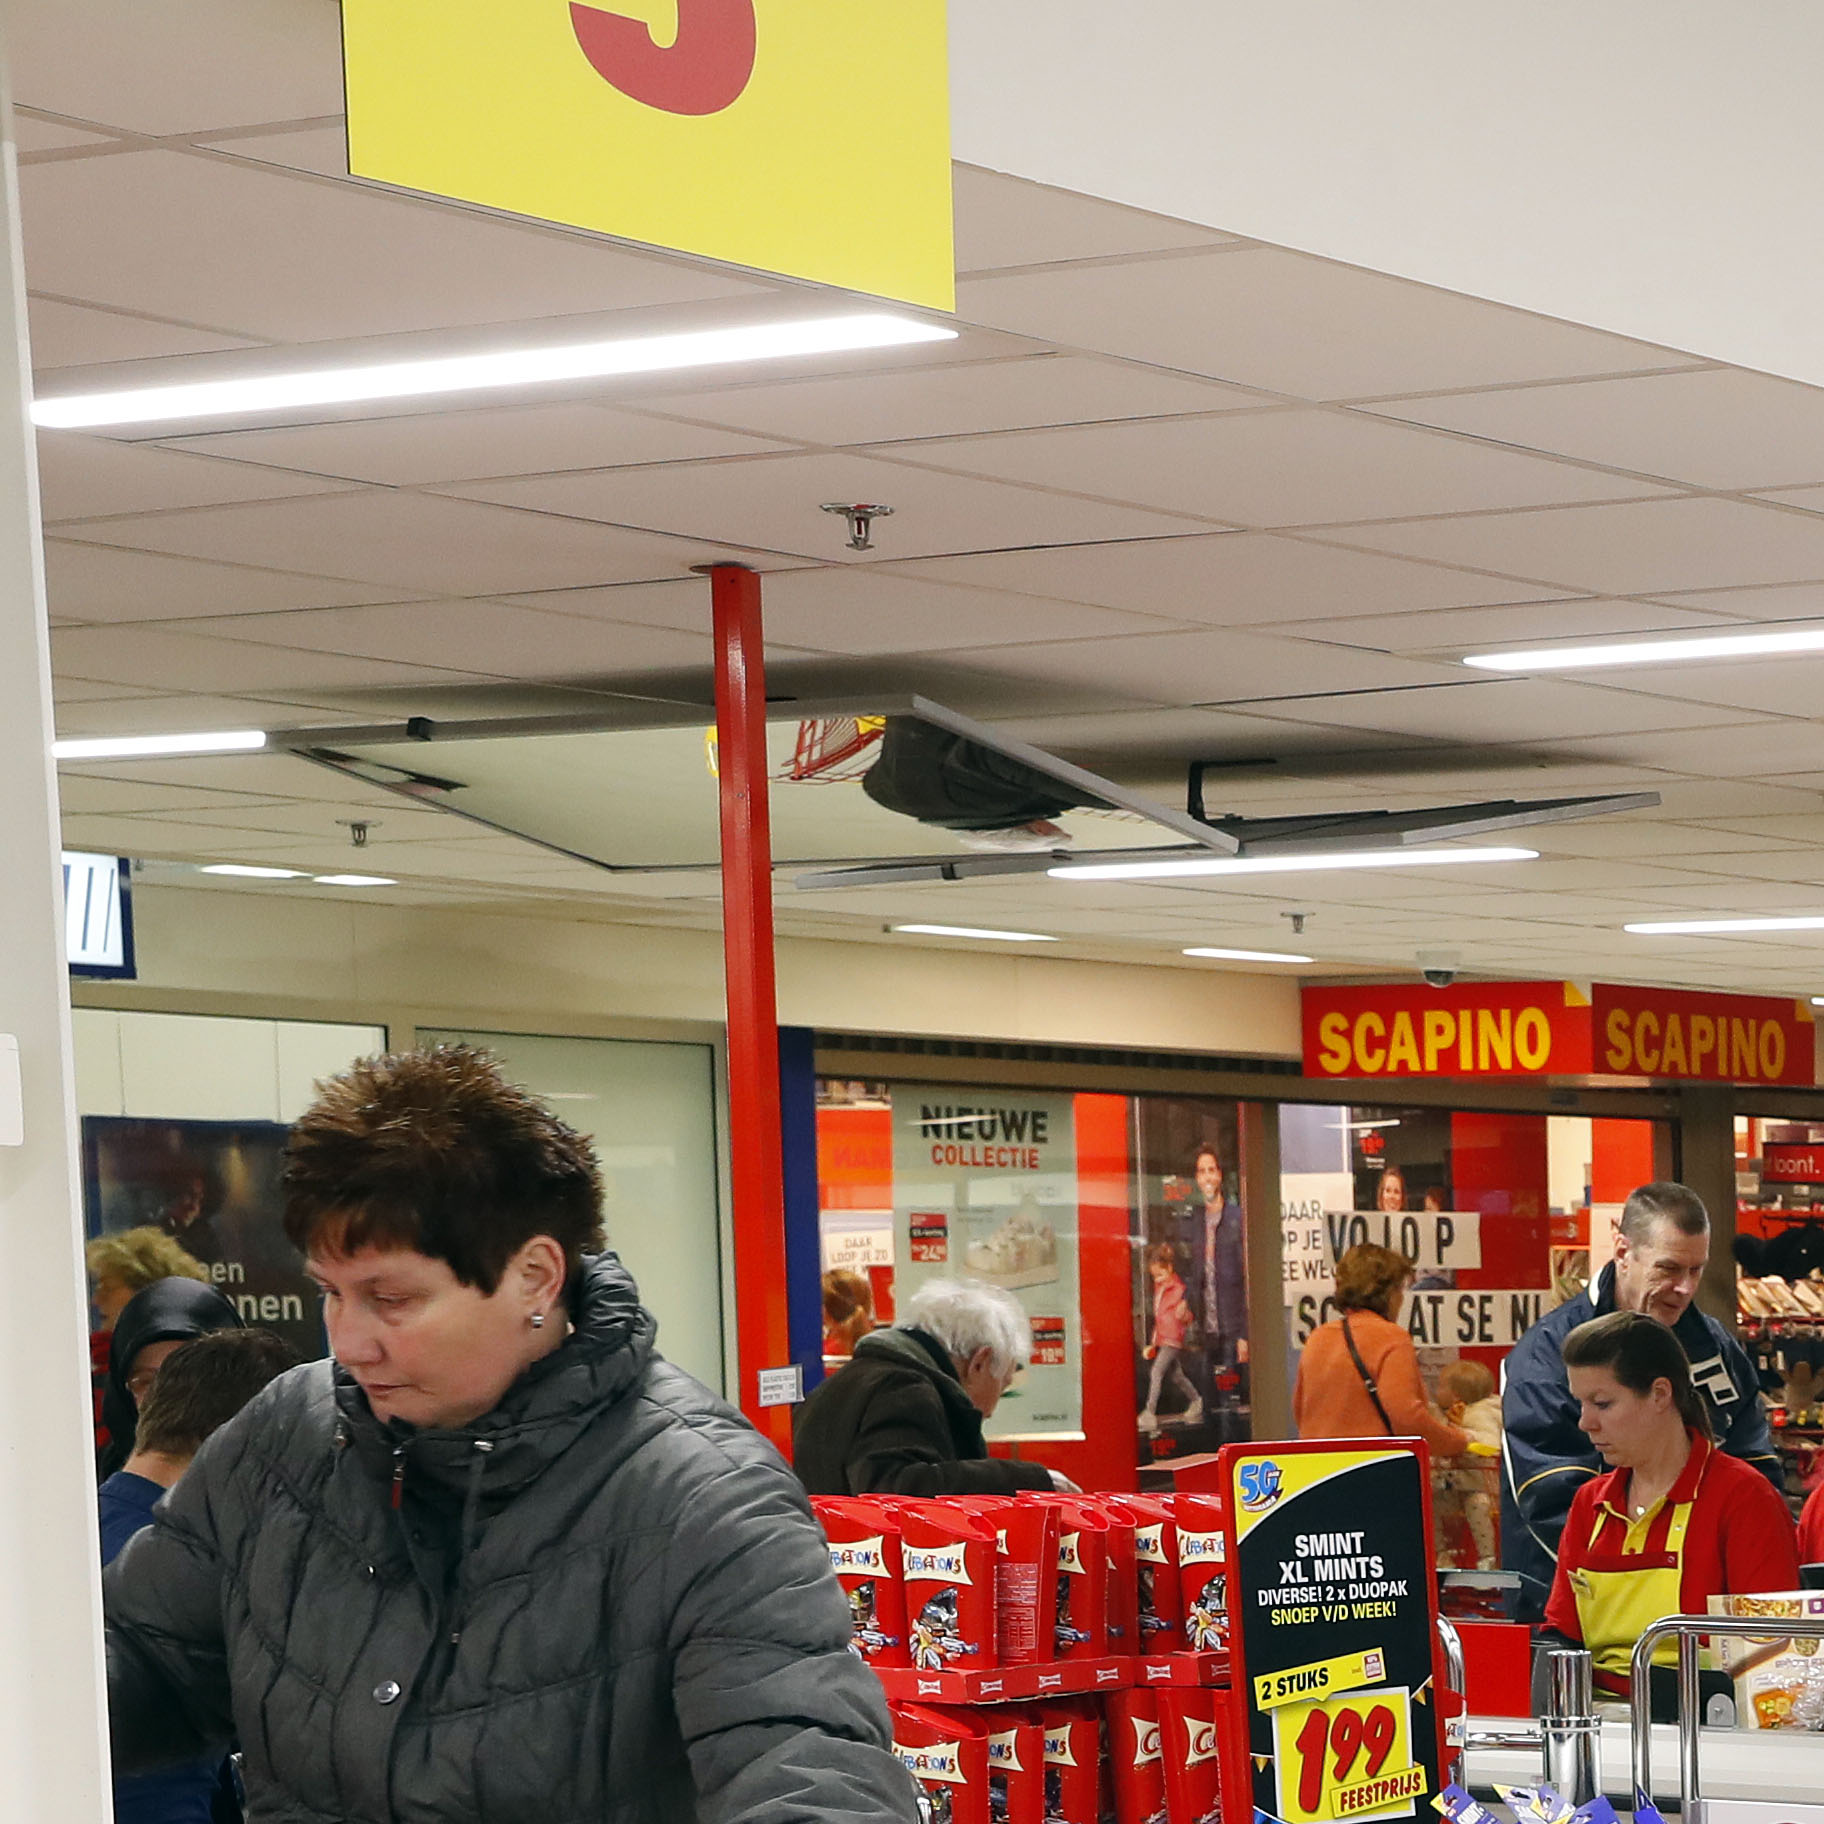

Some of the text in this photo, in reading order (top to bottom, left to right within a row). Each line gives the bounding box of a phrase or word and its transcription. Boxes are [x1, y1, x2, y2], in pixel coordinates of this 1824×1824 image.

[1318, 1006, 1552, 1076] SCAPINO
[1605, 1006, 1786, 1080] SCAPINO
[919, 1103, 1049, 1145] NIEUWE
[931, 1144, 1041, 1170] COLLECTIE
[1295, 1531, 1365, 1558] SMINT
[1278, 1555, 1385, 1585] XL MINTS
[1257, 1579, 1409, 1607] DIVERSE! 2 x DUOPAK
[1270, 1600, 1397, 1626] SNOEP V/D WEEK!
[1261, 1667, 1329, 1701] 2 STUKS
[1295, 1704, 1397, 1813] 199
[1340, 1771, 1422, 1813] FEESTPRIJS
